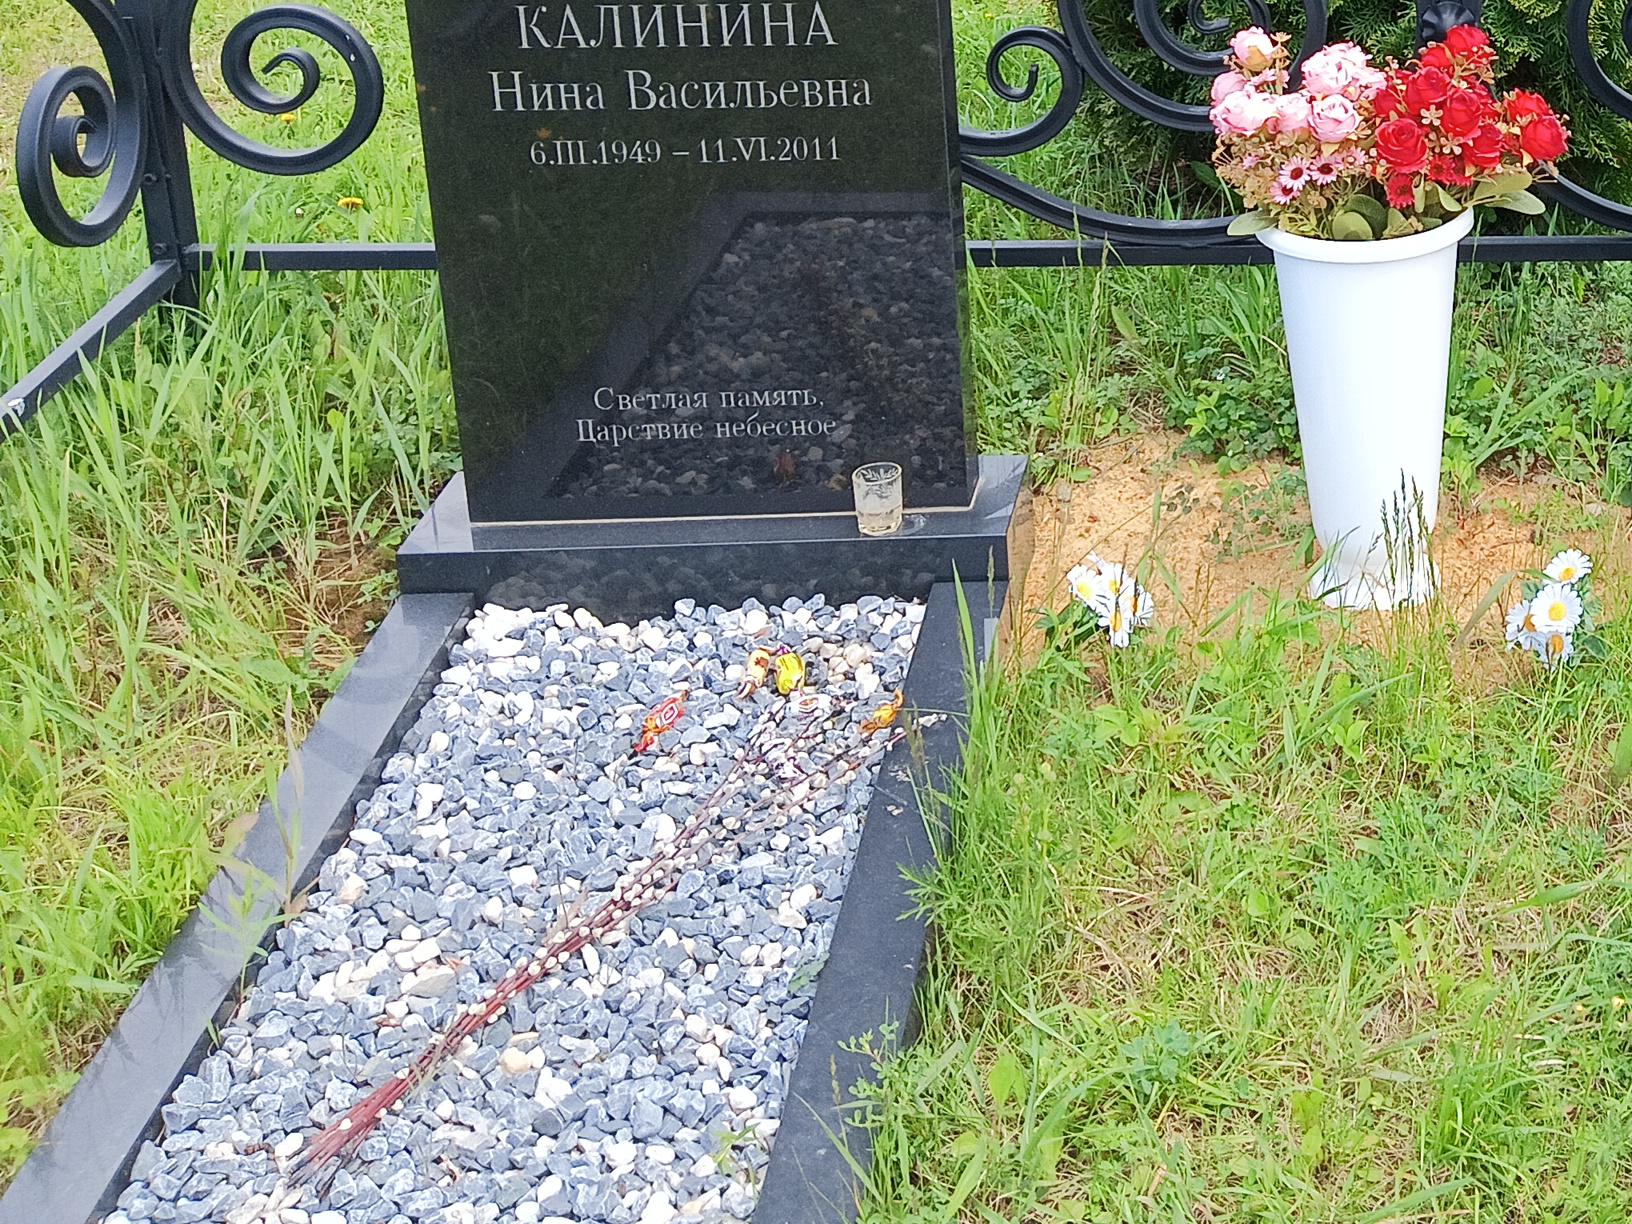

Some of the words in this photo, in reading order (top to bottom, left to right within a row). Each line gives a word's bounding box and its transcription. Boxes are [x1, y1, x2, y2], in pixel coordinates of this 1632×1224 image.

[515, 0, 839, 49] КАЛИНИНА
[487, 70, 606, 112] Нина
[624, 69, 873, 111] Васильевна
[593, 386, 710, 411] Светлая
[719, 388, 825, 409] память,
[576, 418, 703, 447] Царствие
[714, 410, 836, 438] небесное
